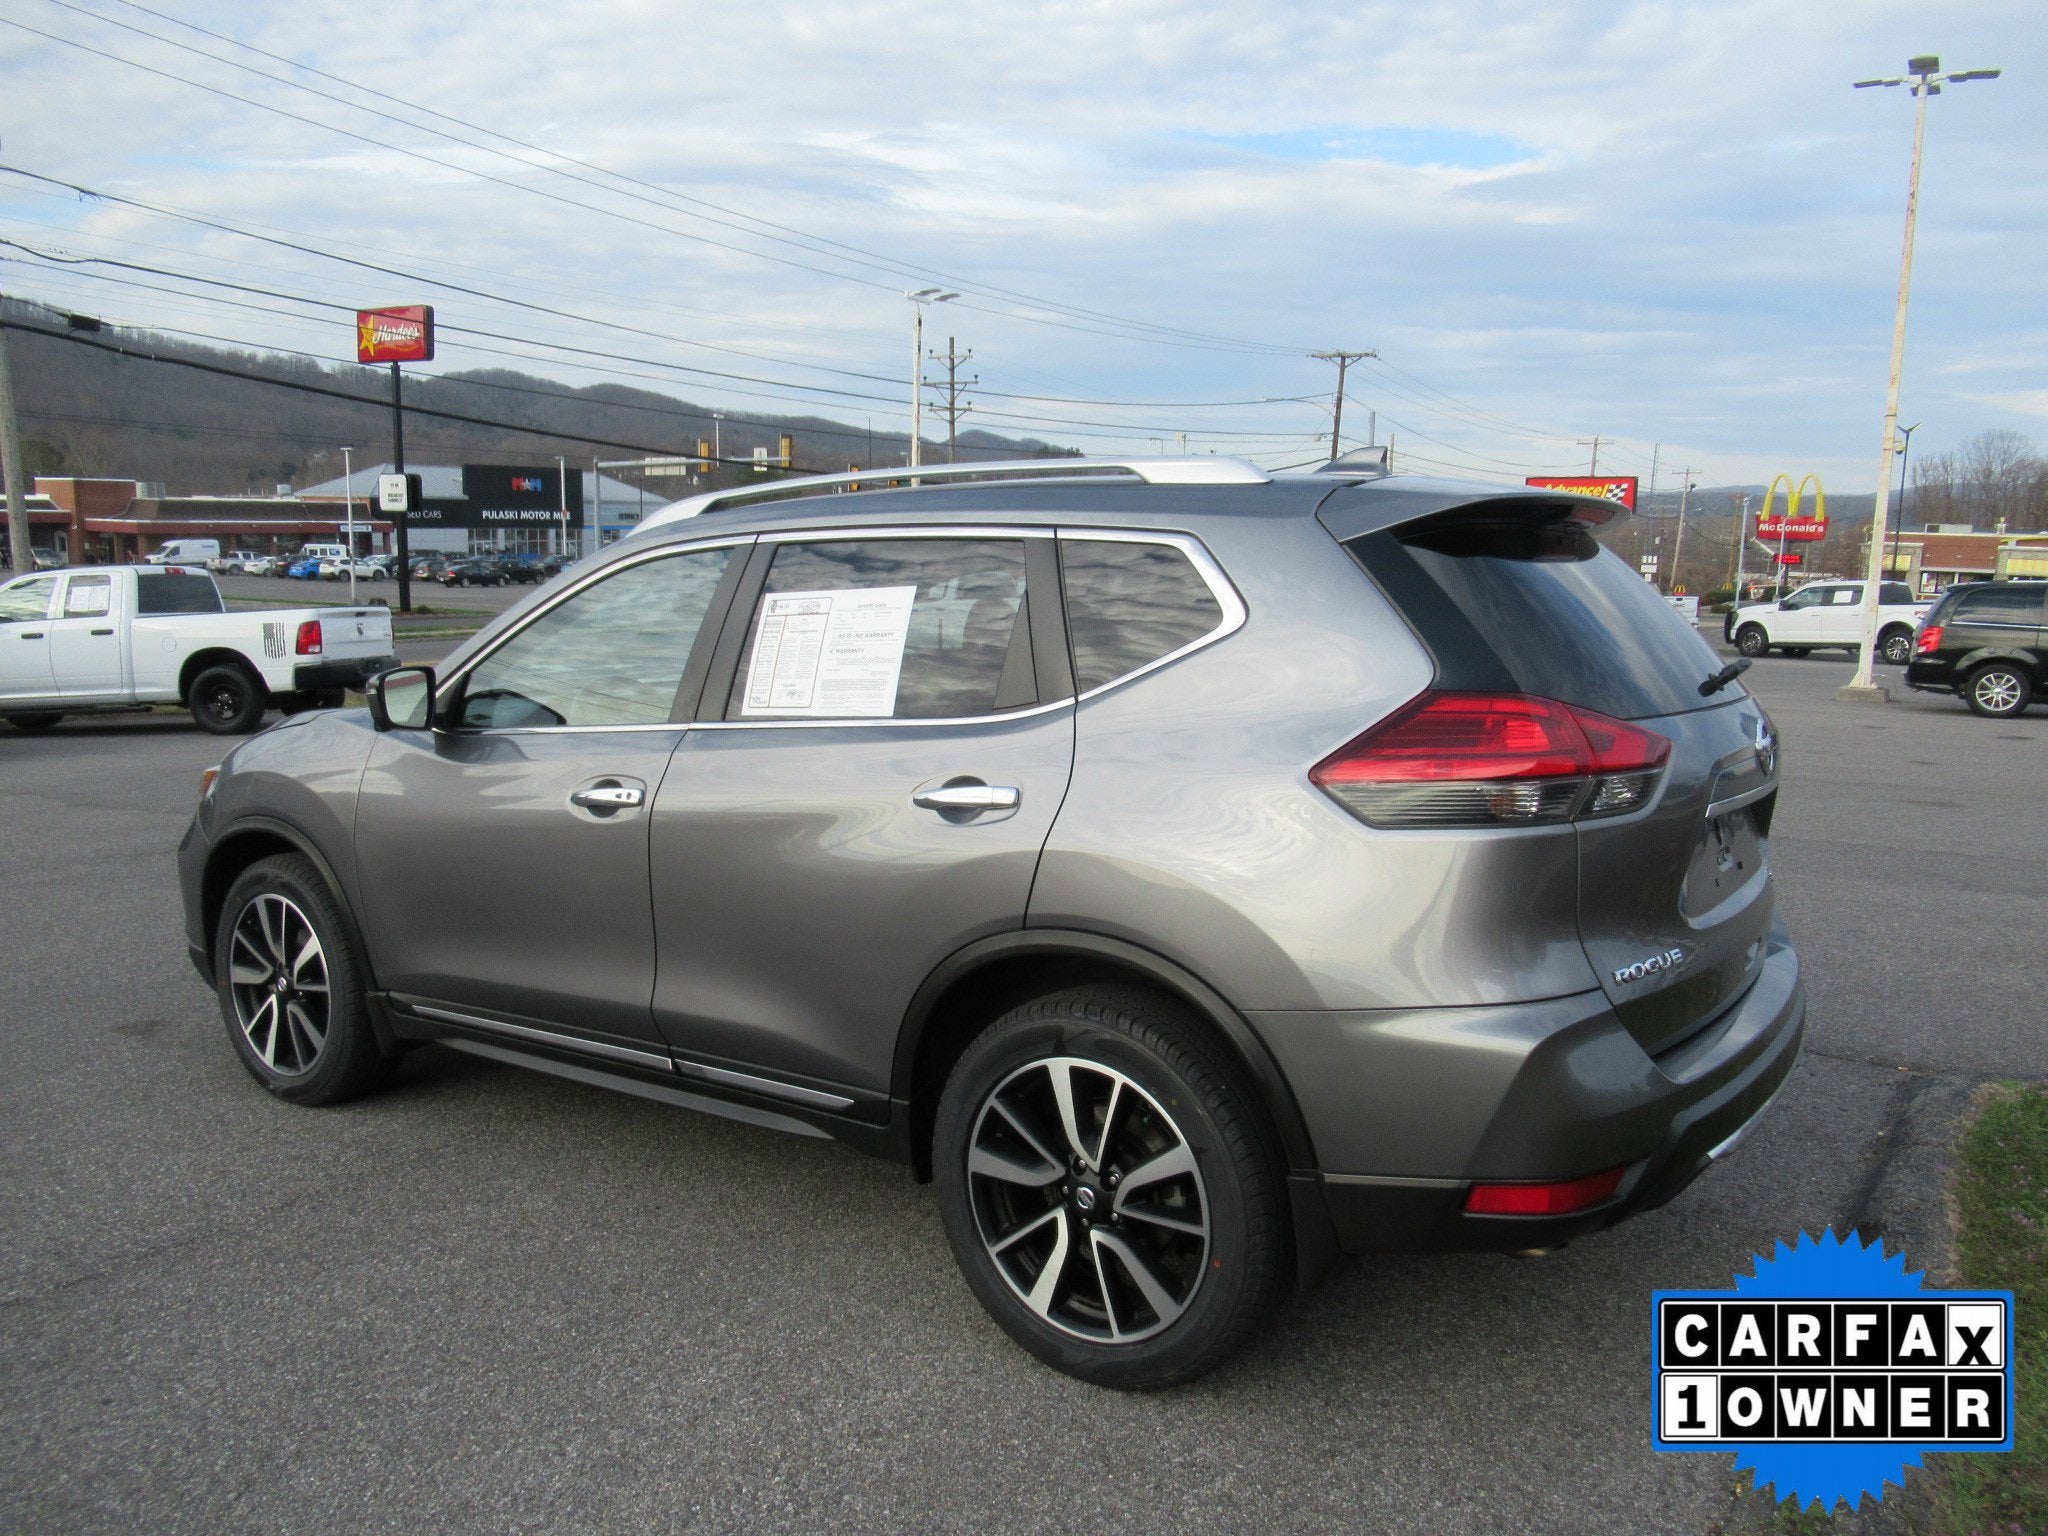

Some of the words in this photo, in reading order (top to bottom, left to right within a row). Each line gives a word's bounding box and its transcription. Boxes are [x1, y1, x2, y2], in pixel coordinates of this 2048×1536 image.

[373, 324, 420, 344] Hardee's
[422, 510, 442, 519] CARS
[482, 510, 518, 520] PULASKI
[520, 510, 551, 520] MOTOR
[553, 510, 572, 520] MIE
[1759, 523, 1824, 532] McDonald's
[1613, 948, 1682, 986] ROGUE
